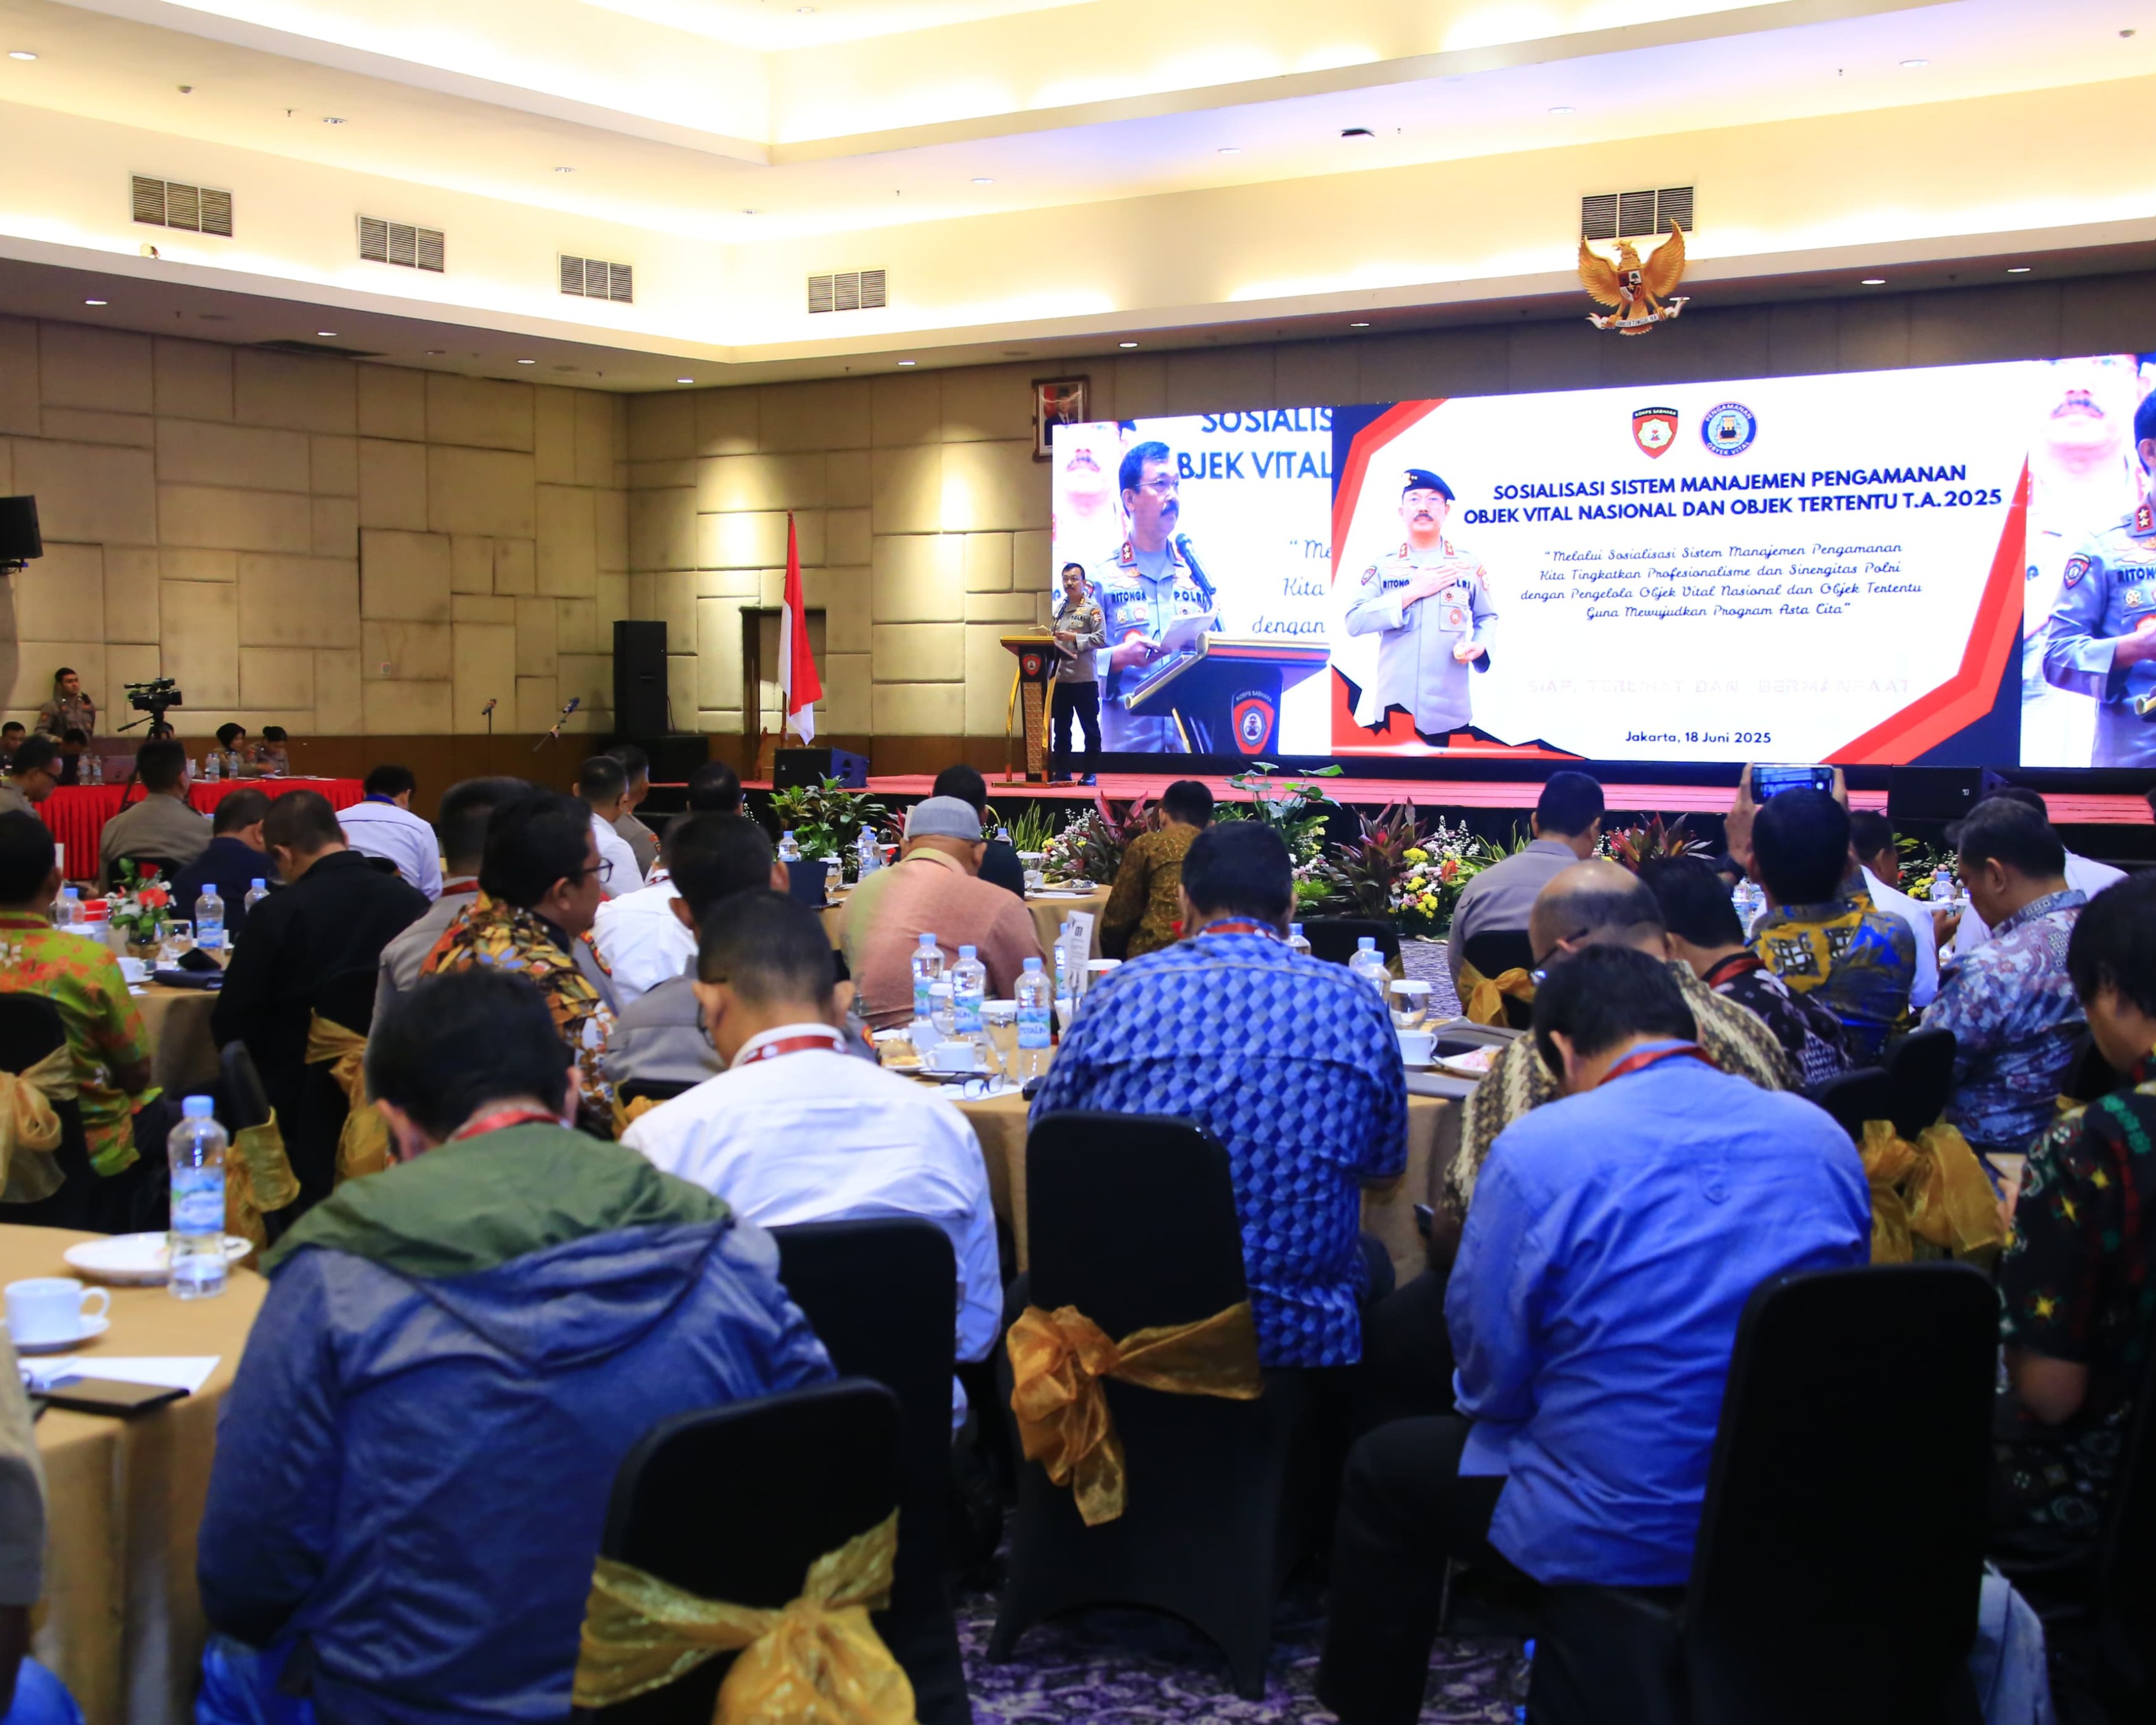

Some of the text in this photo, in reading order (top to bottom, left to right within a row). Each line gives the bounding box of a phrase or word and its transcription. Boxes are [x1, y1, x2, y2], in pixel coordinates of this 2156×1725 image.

[1705, 404, 1753, 422] PENGAMANAN
[1707, 441, 1750, 456] OBYEK VITAL
[1177, 451, 1332, 480] BJEK VITAL
[1493, 464, 1966, 500] SOSIALISASI SISTEM MANAJEMEN PENGAMANAN
[1463, 488, 2002, 524] OBJEK VITAL NASIONAL DAN OBJEK TERTENTU T.A.2025
[1608, 548, 1676, 560] Sosialisasi
[1681, 547, 1723, 558] Sistem
[1729, 545, 1805, 560] Manajemen
[1812, 543, 1903, 558] Pengamanan
[1540, 561, 1901, 583] Kita Tingkatkan Profesionalisme dan Sinergitas Polri
[1283, 576, 1325, 596] Kita
[1520, 582, 1922, 603] dengan Pengelola Objek Vital Nasional dan Objek Tertentu
[1111, 591, 1148, 604] RITONGA
[1173, 591, 1206, 604] POLRI
[1586, 607, 1619, 621] Guna
[1625, 605, 1707, 620] Mewujudkan
[1714, 605, 1773, 619] Program
[1779, 603, 1810, 615] Asta
[1625, 730, 1772, 744] Jakarta, 18 Juni 2025
